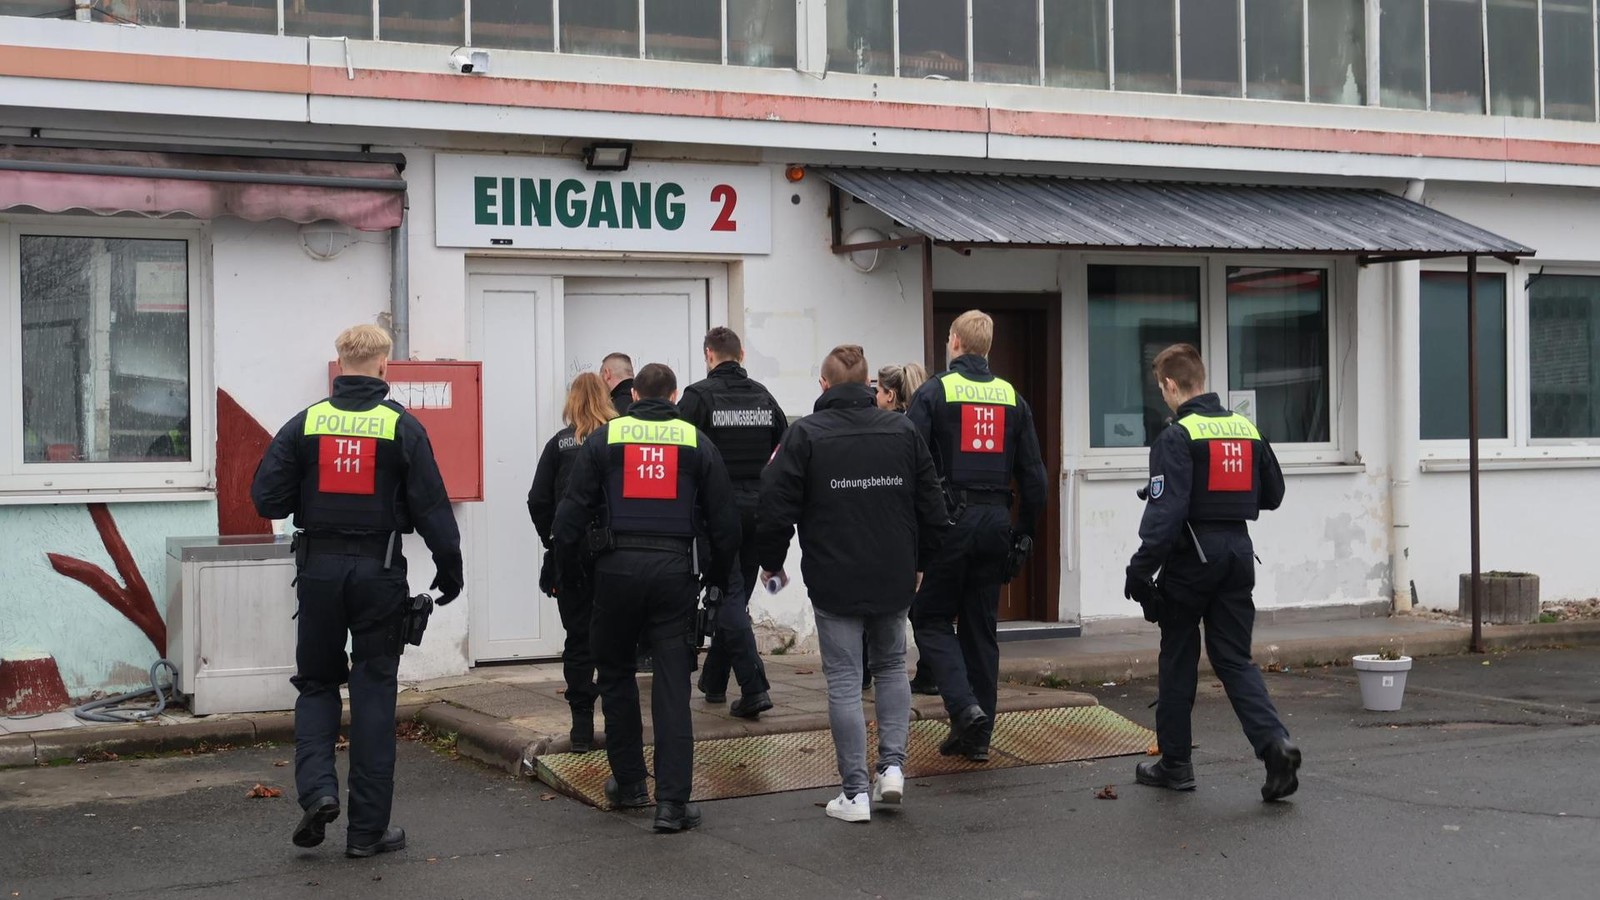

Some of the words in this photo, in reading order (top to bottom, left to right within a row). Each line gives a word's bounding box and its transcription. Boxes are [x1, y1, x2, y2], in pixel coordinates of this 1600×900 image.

[474, 176, 686, 231] EINGANG
[710, 184, 738, 232] 2
[954, 384, 1009, 403] POLIZEI
[712, 406, 773, 426] ORDNUNGSBEHÖRDE
[974, 407, 994, 421] TH
[315, 414, 385, 436] POLIZEI
[621, 424, 685, 442] POLIZEI
[974, 422, 994, 436] 111
[1197, 421, 1253, 437] POLIZEI
[335, 438, 361, 455] TH
[640, 447, 664, 462] TH
[1221, 442, 1242, 457] TH
[333, 457, 360, 474] 111
[637, 464, 665, 479] 113
[1222, 458, 1243, 473] 111
[830, 475, 903, 490] Ordnungsbehörde
